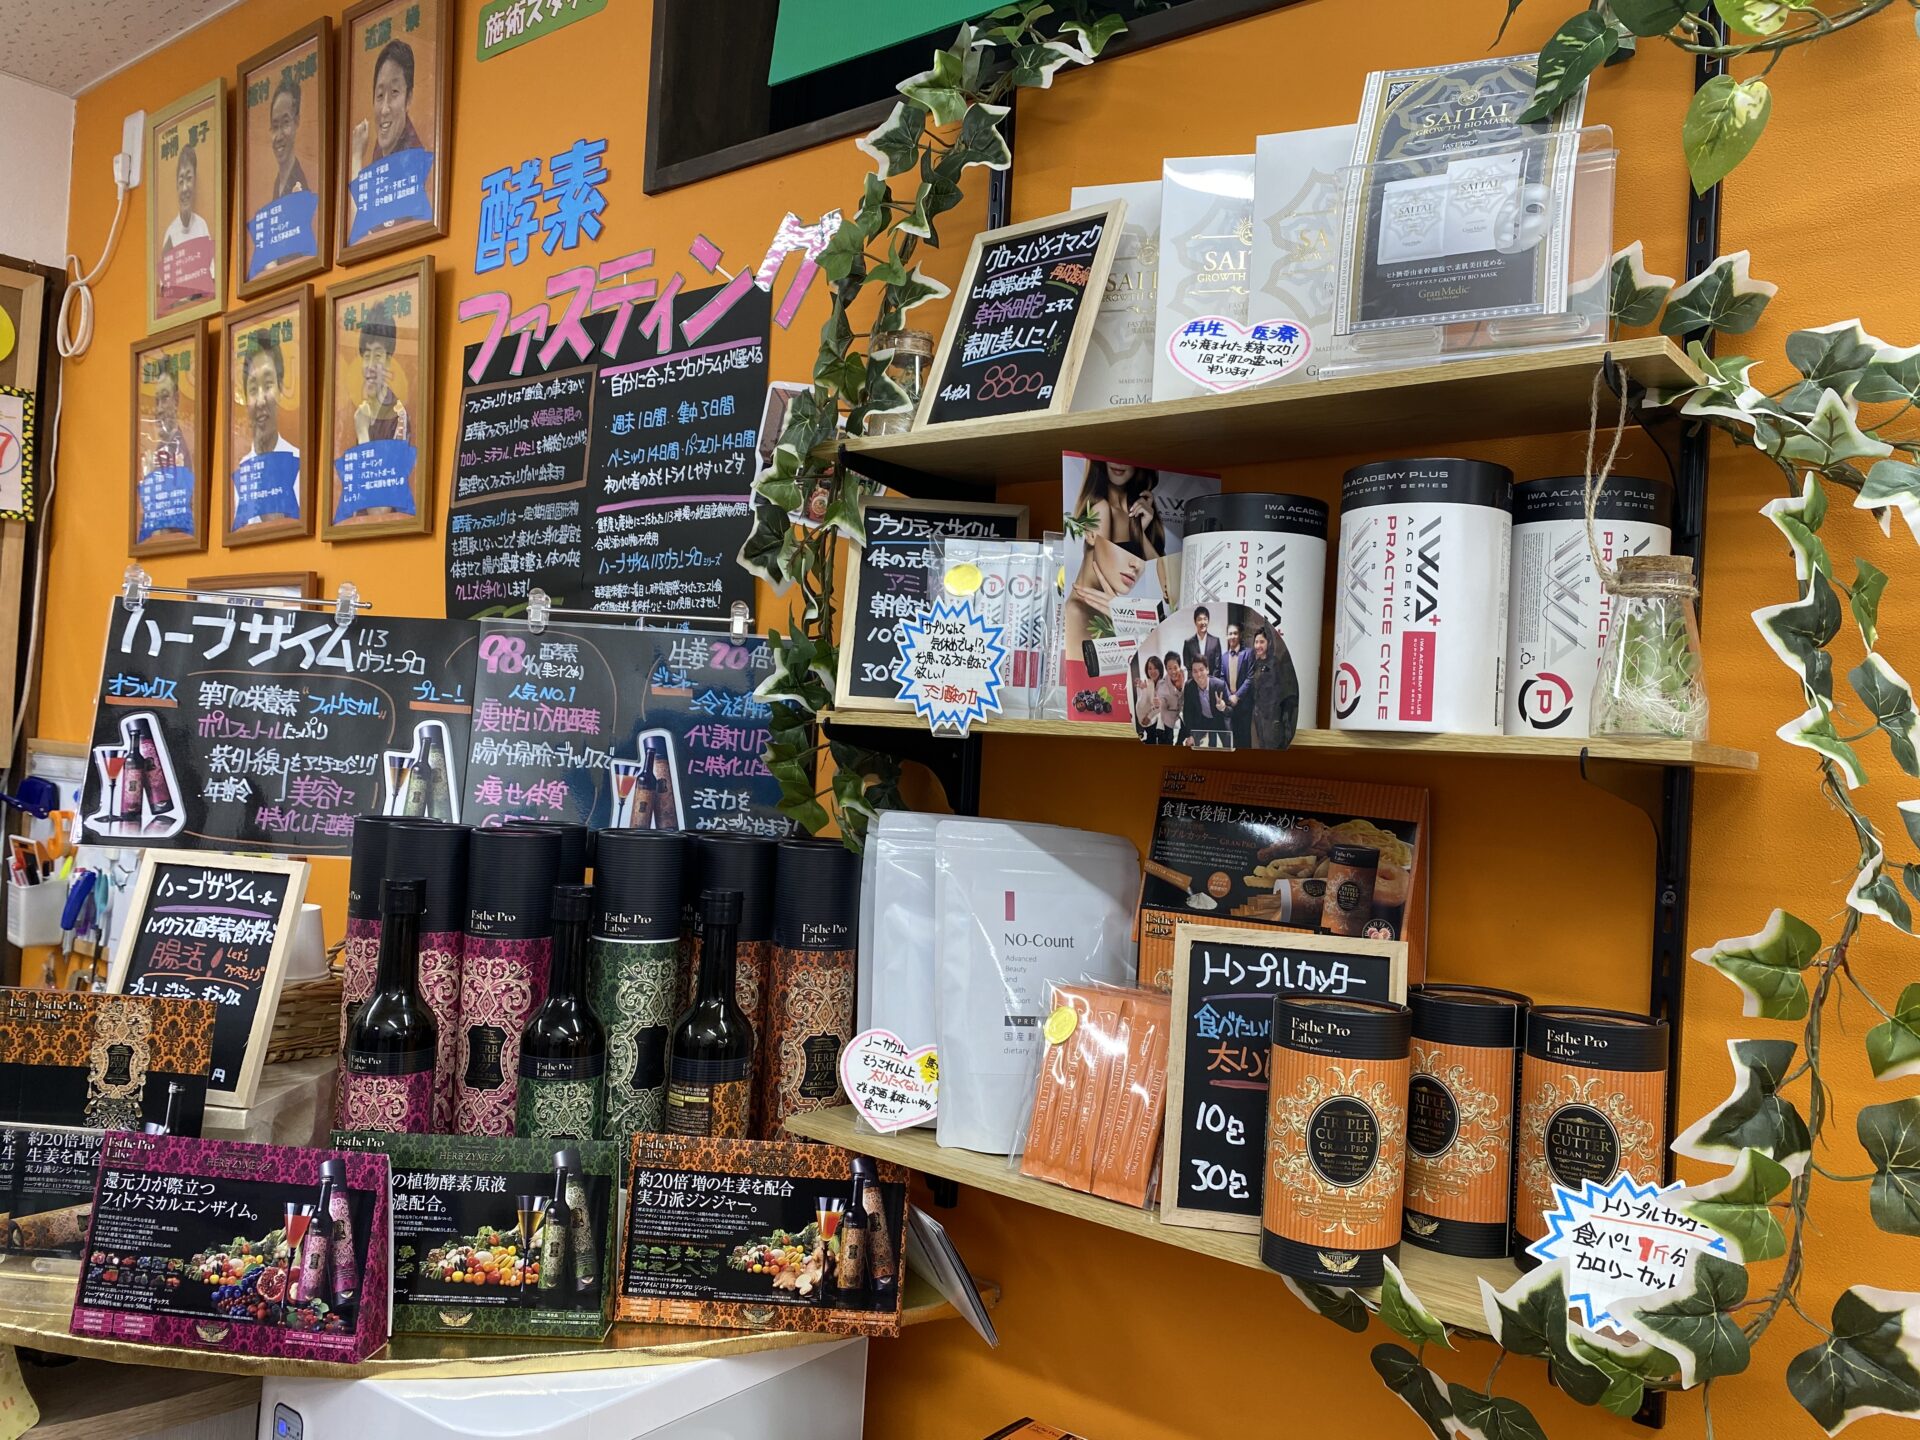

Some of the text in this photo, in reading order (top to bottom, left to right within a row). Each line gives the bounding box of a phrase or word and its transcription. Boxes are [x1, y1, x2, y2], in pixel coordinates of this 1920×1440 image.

[1415, 115, 1513, 137] GROWTH BIO MASK
[1423, 103, 1509, 128] SAITAI
[475, 138, 609, 273] 酵素
[985, 224, 1103, 273] グロースバイオマスク
[1203, 250, 1252, 272] SAI
[1197, 272, 1246, 283] GROWTH
[458, 207, 844, 384] ファスティング
[972, 291, 1074, 329] 幹細胞 エキス
[1183, 320, 1300, 344] 再生 医療
[977, 363, 1044, 401] 8800
[1037, 386, 1053, 400] 円
[1351, 470, 1449, 486] ACADEMY PLUS
[1402, 516, 1415, 622] ACADEMY
[1377, 515, 1398, 721] PRACTICE CYCLE
[121, 606, 390, 673] ハーブザイム 113
[357, 648, 426, 675] グランプロ
[539, 642, 580, 664] 酵素
[1416, 651, 1425, 692] ACADEMY
[108, 672, 178, 701] オラックス
[412, 680, 465, 703] プレーン
[1415, 693, 1424, 716] PLUS
[287, 774, 356, 809] 美容に
[474, 775, 570, 811] 痩せ体質
[690, 787, 751, 813] 活力を
[1161, 800, 1310, 833] 食事で後悔しないために。
[157, 871, 255, 904] ハーブザイム
[471, 909, 517, 923] Esthe Pro
[605, 912, 652, 924] Esthe Pro
[604, 922, 630, 933] Labo
[802, 923, 848, 935] Esthe Pro
[1146, 923, 1171, 936] Labo
[802, 934, 829, 944] Labo
[1004, 933, 1075, 949] NO-Count
[1005, 954, 1038, 963] Advanced
[1005, 965, 1027, 974] Beauty
[1203, 951, 1367, 994] トリプルカッター
[35, 1001, 87, 1011] Esthe Pro
[1194, 1002, 1272, 1040] 食べたい
[1292, 1017, 1351, 1038] Esthe Pro
[1291, 1030, 1324, 1046] Labo
[1546, 1029, 1609, 1050] Esthe Pro
[351, 1054, 382, 1064] Esthe Pro
[1003, 1047, 1030, 1056] dietary
[1545, 1044, 1580, 1057] Labo
[212, 1069, 226, 1083] 円
[536, 1062, 573, 1073] Esthe Pro
[808, 1062, 834, 1071] ZYME
[863, 1054, 916, 1078] もうこれ以上
[809, 1087, 830, 1096] Ginger
[1116, 1092, 1131, 1132] CUTTER
[1196, 1101, 1246, 1146] 10包
[1555, 1121, 1607, 1140] TRIPLE
[108, 1138, 156, 1151] Esthe Pro
[336, 1136, 385, 1148] Esthe Pro
[1551, 1134, 1612, 1154] CUTTER
[1555, 1147, 1605, 1163] GRAN PRO
[103, 1171, 216, 1196] 還元力が際立つ
[1191, 1158, 1250, 1200] 30包
[101, 1191, 259, 1221] フィトケミカルエンザイム。
[637, 1189, 759, 1214] 実力派ジンジャー。
